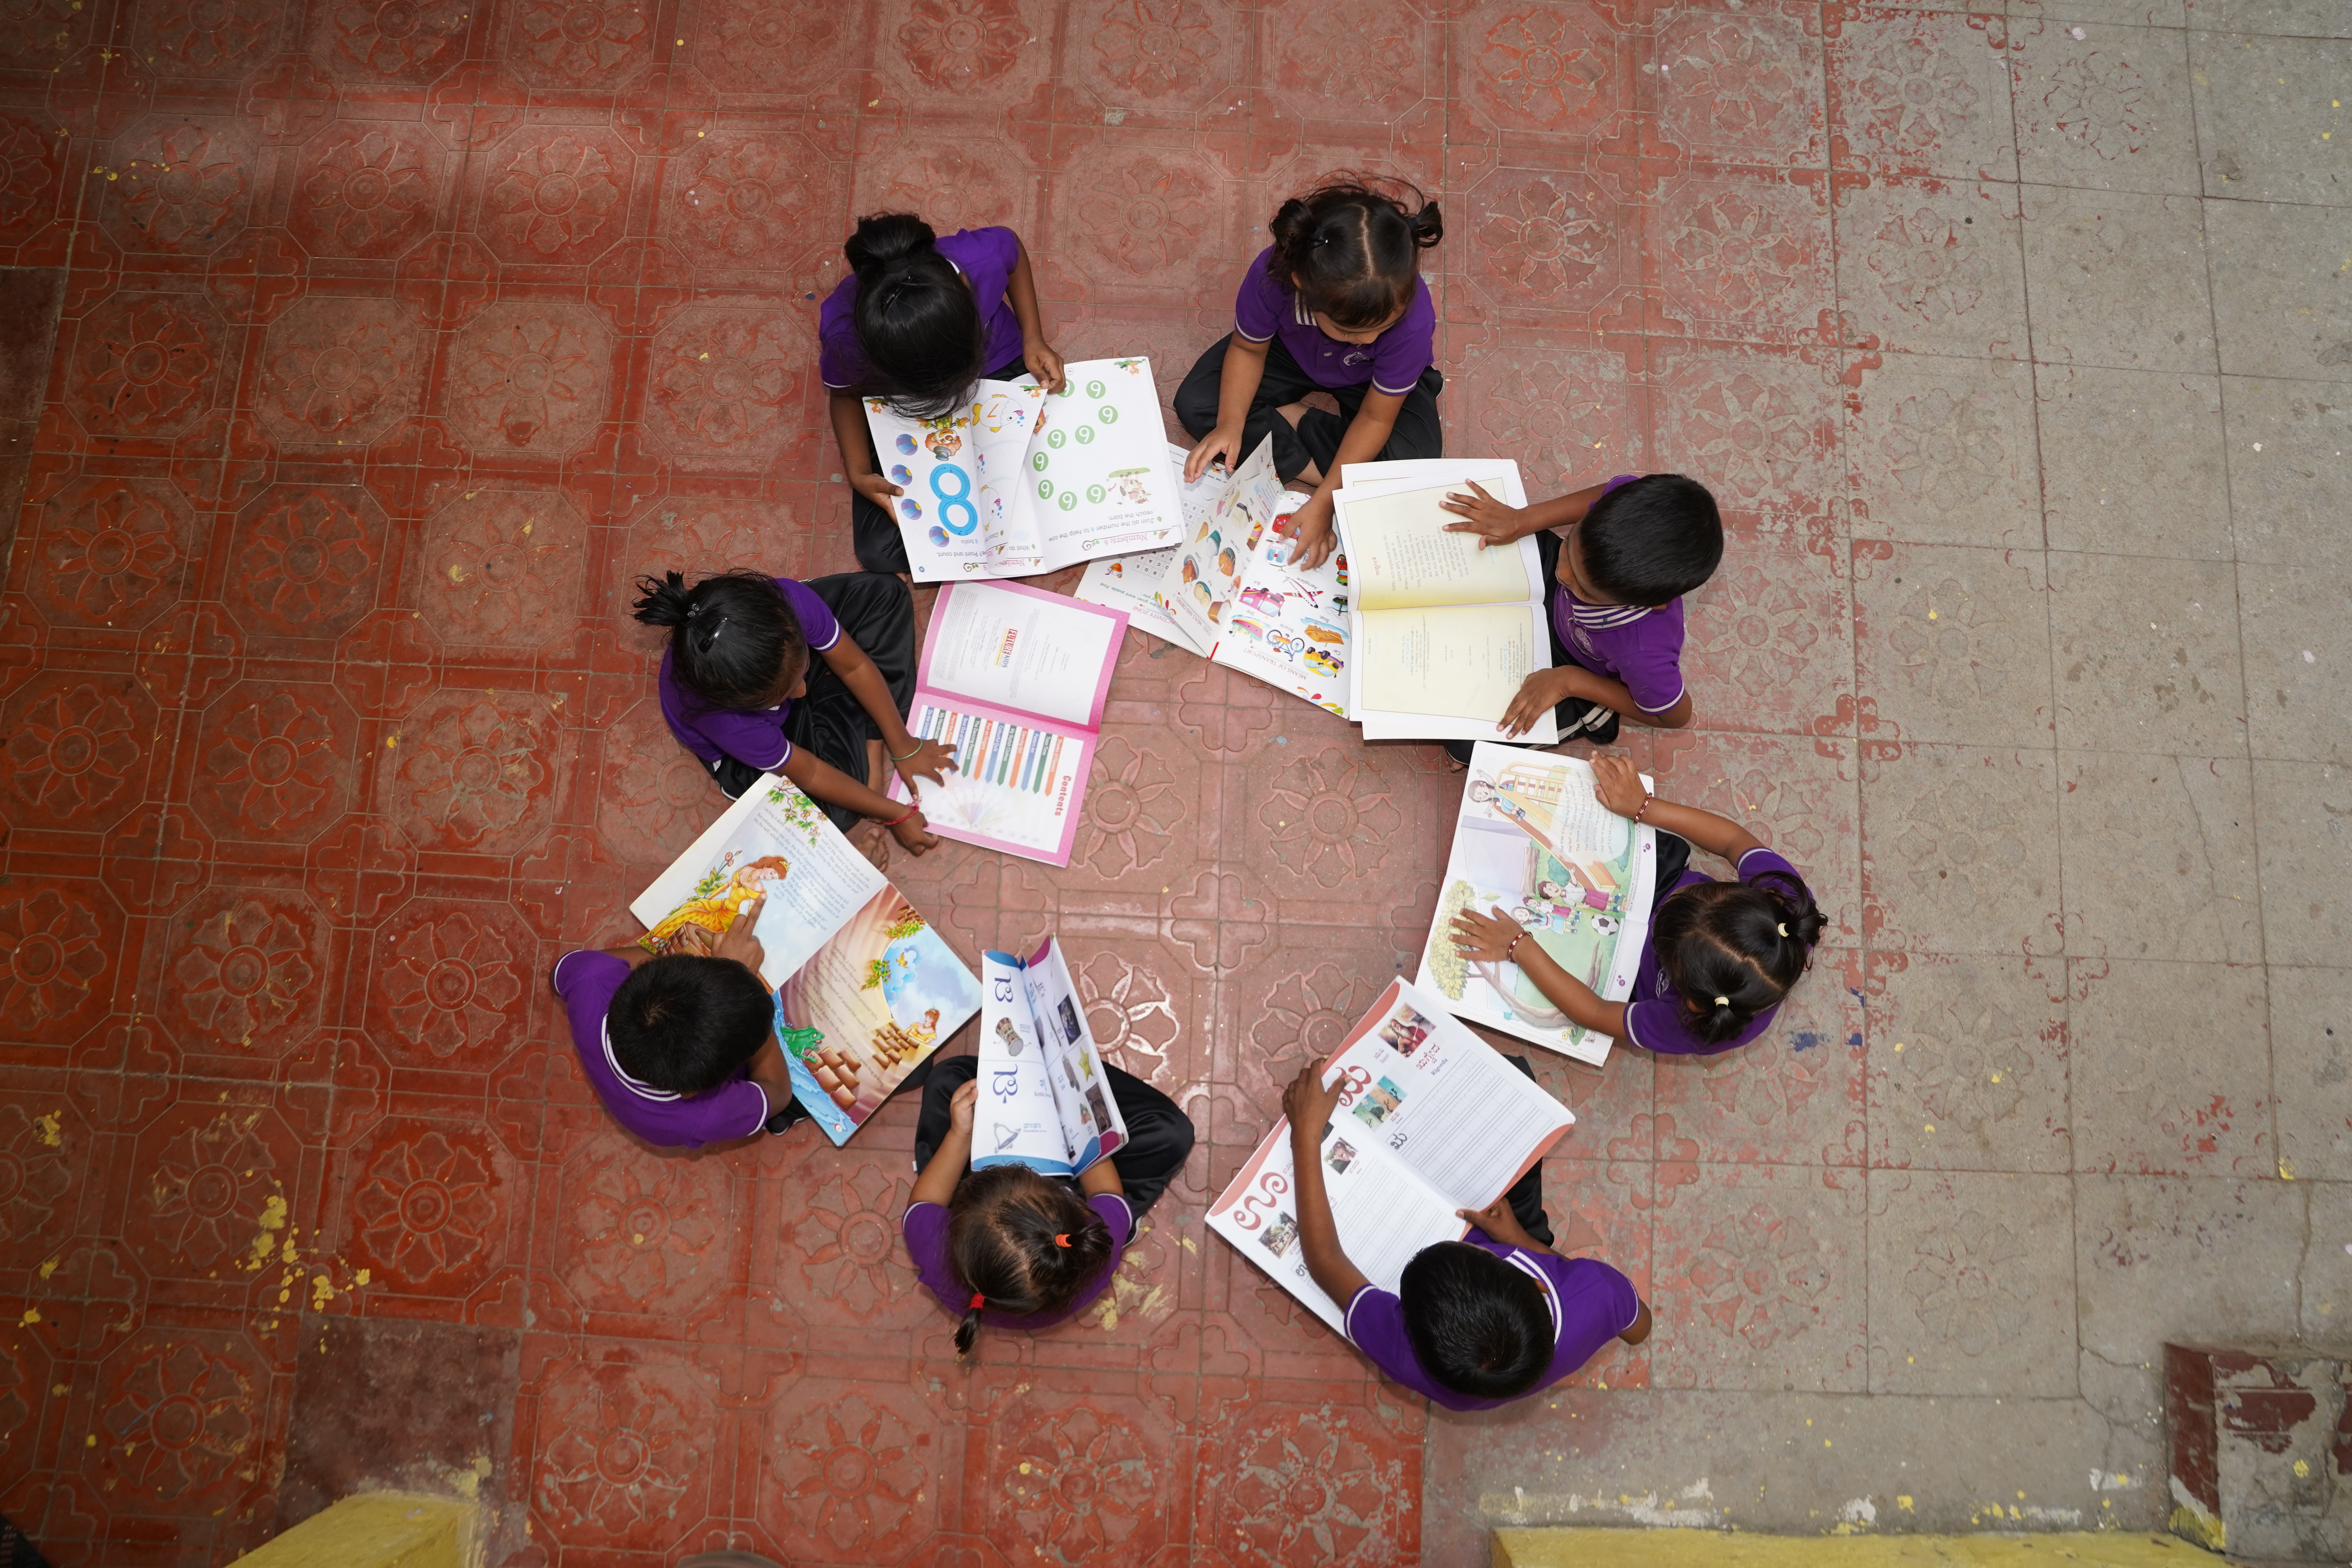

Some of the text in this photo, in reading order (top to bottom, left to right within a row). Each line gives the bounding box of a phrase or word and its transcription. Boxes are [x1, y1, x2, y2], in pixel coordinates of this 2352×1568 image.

[1090, 382, 1102, 397] 6
[985, 403, 1000, 418] 7
[1102, 407, 1113, 423] 6
[1051, 431, 1062, 447] 6
[1079, 427, 1090, 443] 6
[1036, 454, 1044, 469] 6
[1041, 482, 1050, 497] 6
[1091, 487, 1101, 503] 6
[930, 463, 978, 536] 8
[1062, 493, 1073, 509] 6
[1110, 533, 1147, 545] Numbers:
[1296, 576, 1318, 590] Aeroplane
[1175, 596, 1186, 610] DRINKS
[1132, 605, 1176, 625] ACTIVITY ZONE
[1192, 614, 1202, 626] MEALS
[1318, 615, 1330, 623] Boat
[1202, 625, 1211, 636] FOOD
[1279, 622, 1294, 633] Bicycle
[1002, 629, 1017, 668] FUTURE KIDS
[1243, 647, 1307, 680] MEANS OF TRANSPORT
[969, 727, 977, 744] Dancing
[995, 725, 1003, 742] Colourful
[1018, 730, 1027, 747] Dancing
[980, 735, 988, 750] Fingers
[1054, 775, 1072, 817] Contents
[1379, 1053, 1390, 1063] Saint
[1430, 1057, 1448, 1076] Rigveda
